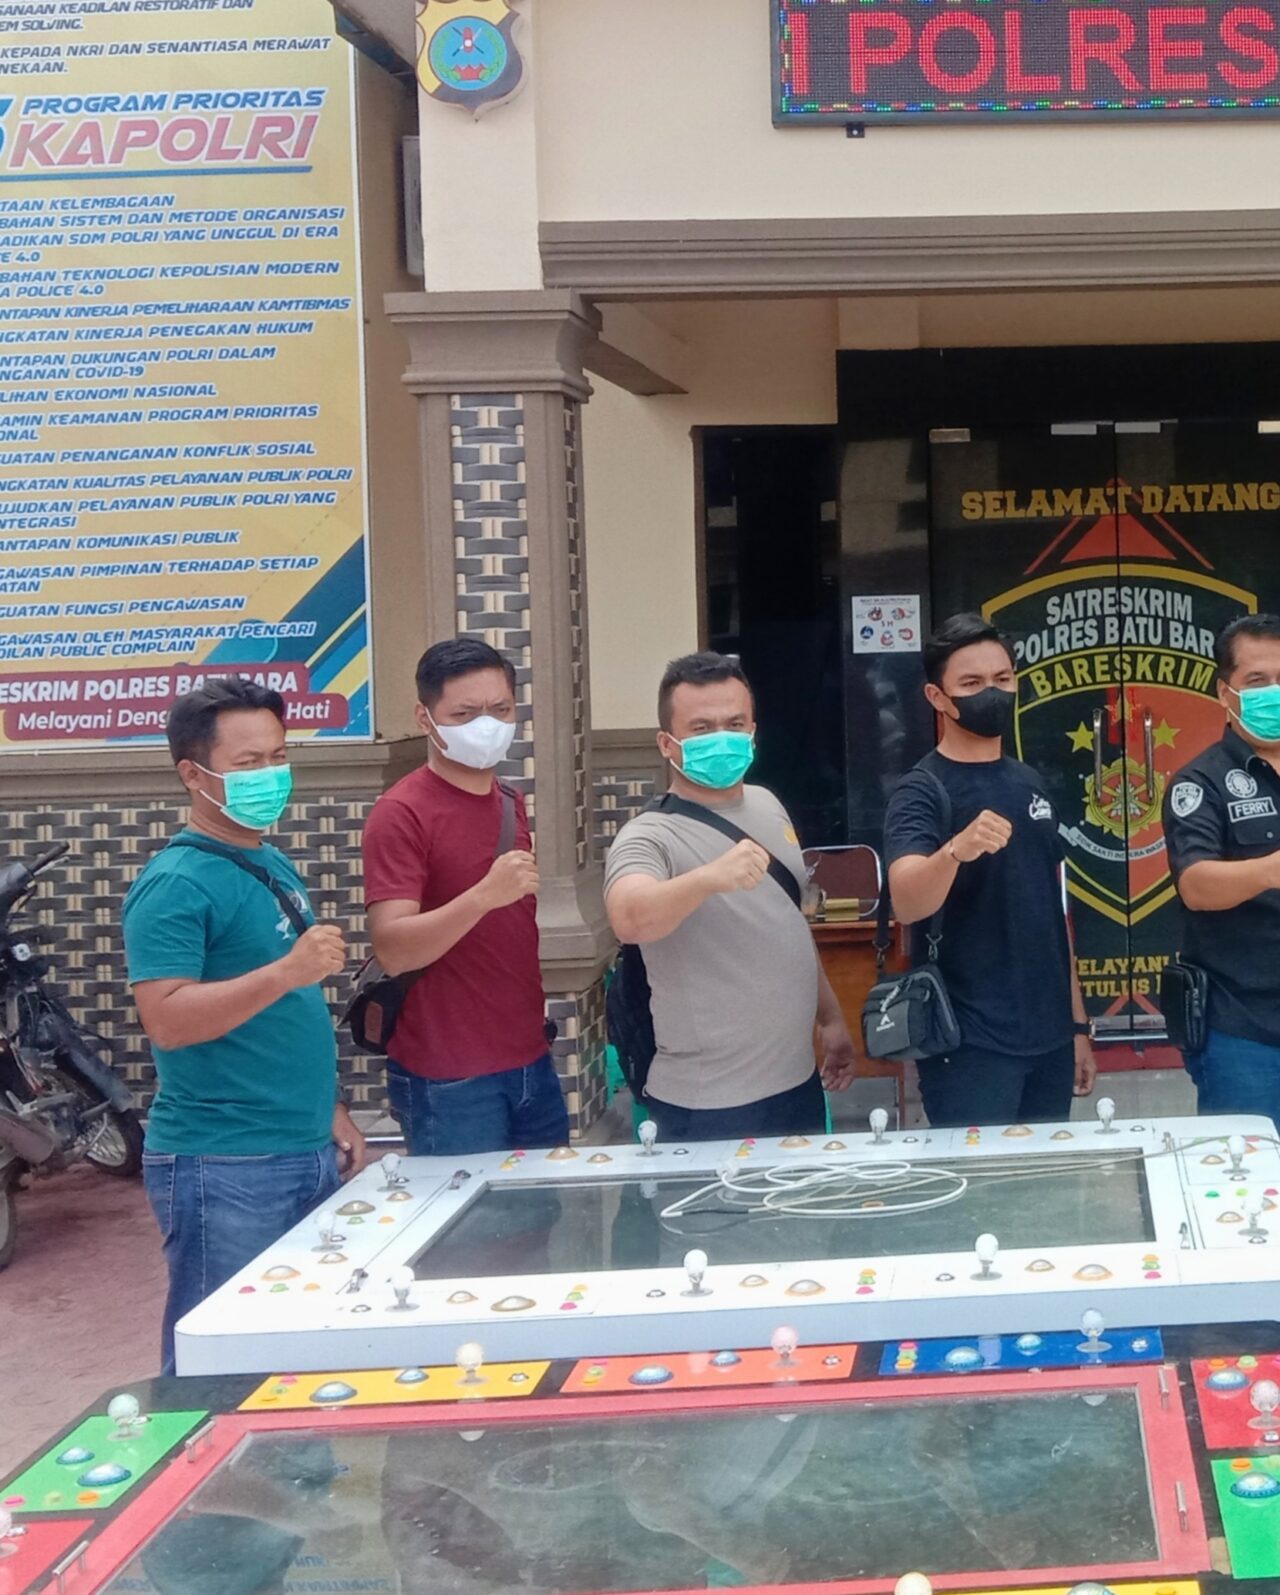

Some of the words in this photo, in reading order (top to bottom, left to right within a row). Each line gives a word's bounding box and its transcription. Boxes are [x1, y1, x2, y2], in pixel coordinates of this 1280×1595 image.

[59, 1, 129, 14] KEADILAN
[135, 0, 220, 12] RESTORATIF
[223, 0, 253, 8] DAN
[21, 19, 84, 30] SOLVING.
[1, 46, 61, 58] KEPADA
[66, 45, 104, 56] NKRI
[109, 43, 142, 54] DAN
[146, 41, 248, 53] SENANTIASA
[253, 39, 330, 51] MERAWAT
[848, 6, 1280, 94] POLRES
[23, 95, 167, 115] PROGRAM
[172, 91, 326, 110] PRIORITAS
[9, 114, 319, 167] KAPOLRI
[49, 196, 174, 209] KELEMBAGAAN
[60, 215, 122, 226] SISTEM
[127, 213, 162, 224] DAN
[169, 211, 237, 222] METODE
[243, 208, 345, 220] ORGANISASI
[70, 233, 105, 245] SDM
[110, 232, 158, 243] POLRI
[163, 230, 205, 241] YANG
[210, 228, 276, 239] UNGGUL
[283, 227, 299, 238] DI
[305, 226, 338, 237] ERA
[15, 252, 40, 262] 4.0
[62, 267, 155, 280] TEKNOLOGI
[159, 264, 259, 277] KEPOLISIAN
[265, 262, 339, 274] MODERN
[16, 285, 73, 297] POLICE
[79, 284, 104, 295] 4.0
[64, 306, 128, 318] KINERJA
[133, 301, 253, 315] PEMELIHARAAN
[258, 298, 351, 312] KAMTIBMAS
[74, 328, 143, 340] KINERJA
[148, 324, 250, 337] PENEGAKAN
[256, 322, 313, 333] HUKUM
[71, 351, 160, 365] DUKUNGAN
[166, 350, 212, 361] POLRI
[218, 347, 275, 359] DALAM
[75, 366, 143, 378] COVID-19
[55, 388, 128, 400] EKONOMI
[133, 385, 216, 397] NASIONAL
[48, 411, 142, 425] KEAMANAN
[148, 408, 228, 421] PROGRAM
[233, 405, 317, 418] PRIORITAS
[0, 453, 54, 464] UATAN
[60, 448, 177, 462] PENANGANAN
[183, 445, 251, 457] KONFLIK
[256, 443, 315, 455] SOSIAL
[73, 476, 145, 489] KUALITAS
[150, 473, 242, 486] PELAYANAN
[247, 470, 301, 482] PUBLIK
[306, 469, 353, 480] POLRI
[78, 498, 174, 512] PELAYANAN
[180, 496, 237, 507] PUBLIK
[242, 494, 288, 505] POLRI
[293, 492, 336, 504] YANG
[962, 486, 1132, 520] SELAMAT
[76, 534, 177, 548] KOMUNIKASI
[182, 532, 239, 544] PUBLIK
[80, 564, 163, 577] PIMPINAN
[168, 560, 254, 573] TERHADAP
[259, 557, 318, 570] SETIAP
[64, 602, 123, 614] FUNGSI
[128, 598, 244, 612] PENGAWASAN
[1046, 586, 1193, 625] SATRESKRIM
[83, 632, 125, 643] OLEH
[130, 626, 237, 641] MASYARAKAT
[242, 622, 314, 636] PENCARI
[1105, 617, 1163, 646] BATU
[50, 645, 106, 657] PUBLIC
[111, 640, 195, 655] COMPLAIN
[1029, 651, 1217, 697] BARESKRIM
[84, 676, 170, 700] POLRES
[18, 710, 112, 731] Melayani
[287, 699, 331, 720] Hati
[1235, 801, 1271, 817] FERRY
[1074, 955, 1169, 976] ELAYAN
[1078, 978, 1150, 997] TULUS
